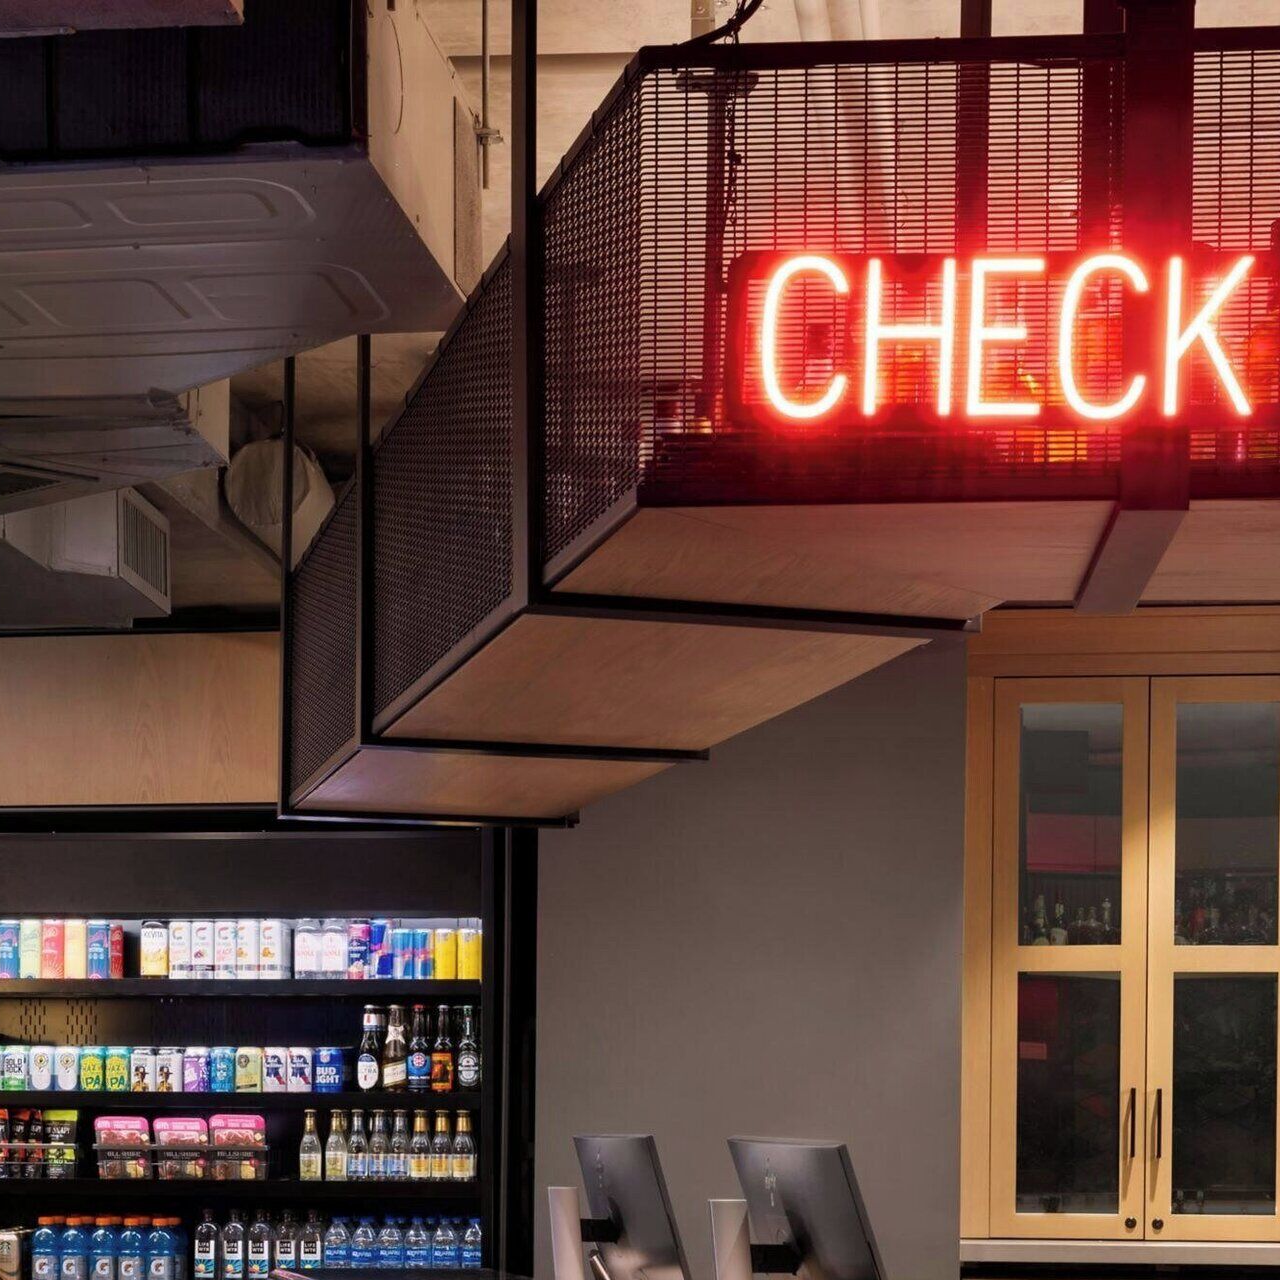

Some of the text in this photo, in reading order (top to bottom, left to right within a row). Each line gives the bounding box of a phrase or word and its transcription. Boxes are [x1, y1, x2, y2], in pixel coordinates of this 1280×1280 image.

[761, 252, 1254, 420] CHECK
[316, 1066, 337, 1075] BUD
[35, 1258, 50, 1275] G
[62, 1259, 76, 1275] G
[95, 1259, 110, 1275] G
[121, 1260, 134, 1276] G
[151, 1259, 165, 1276] G
